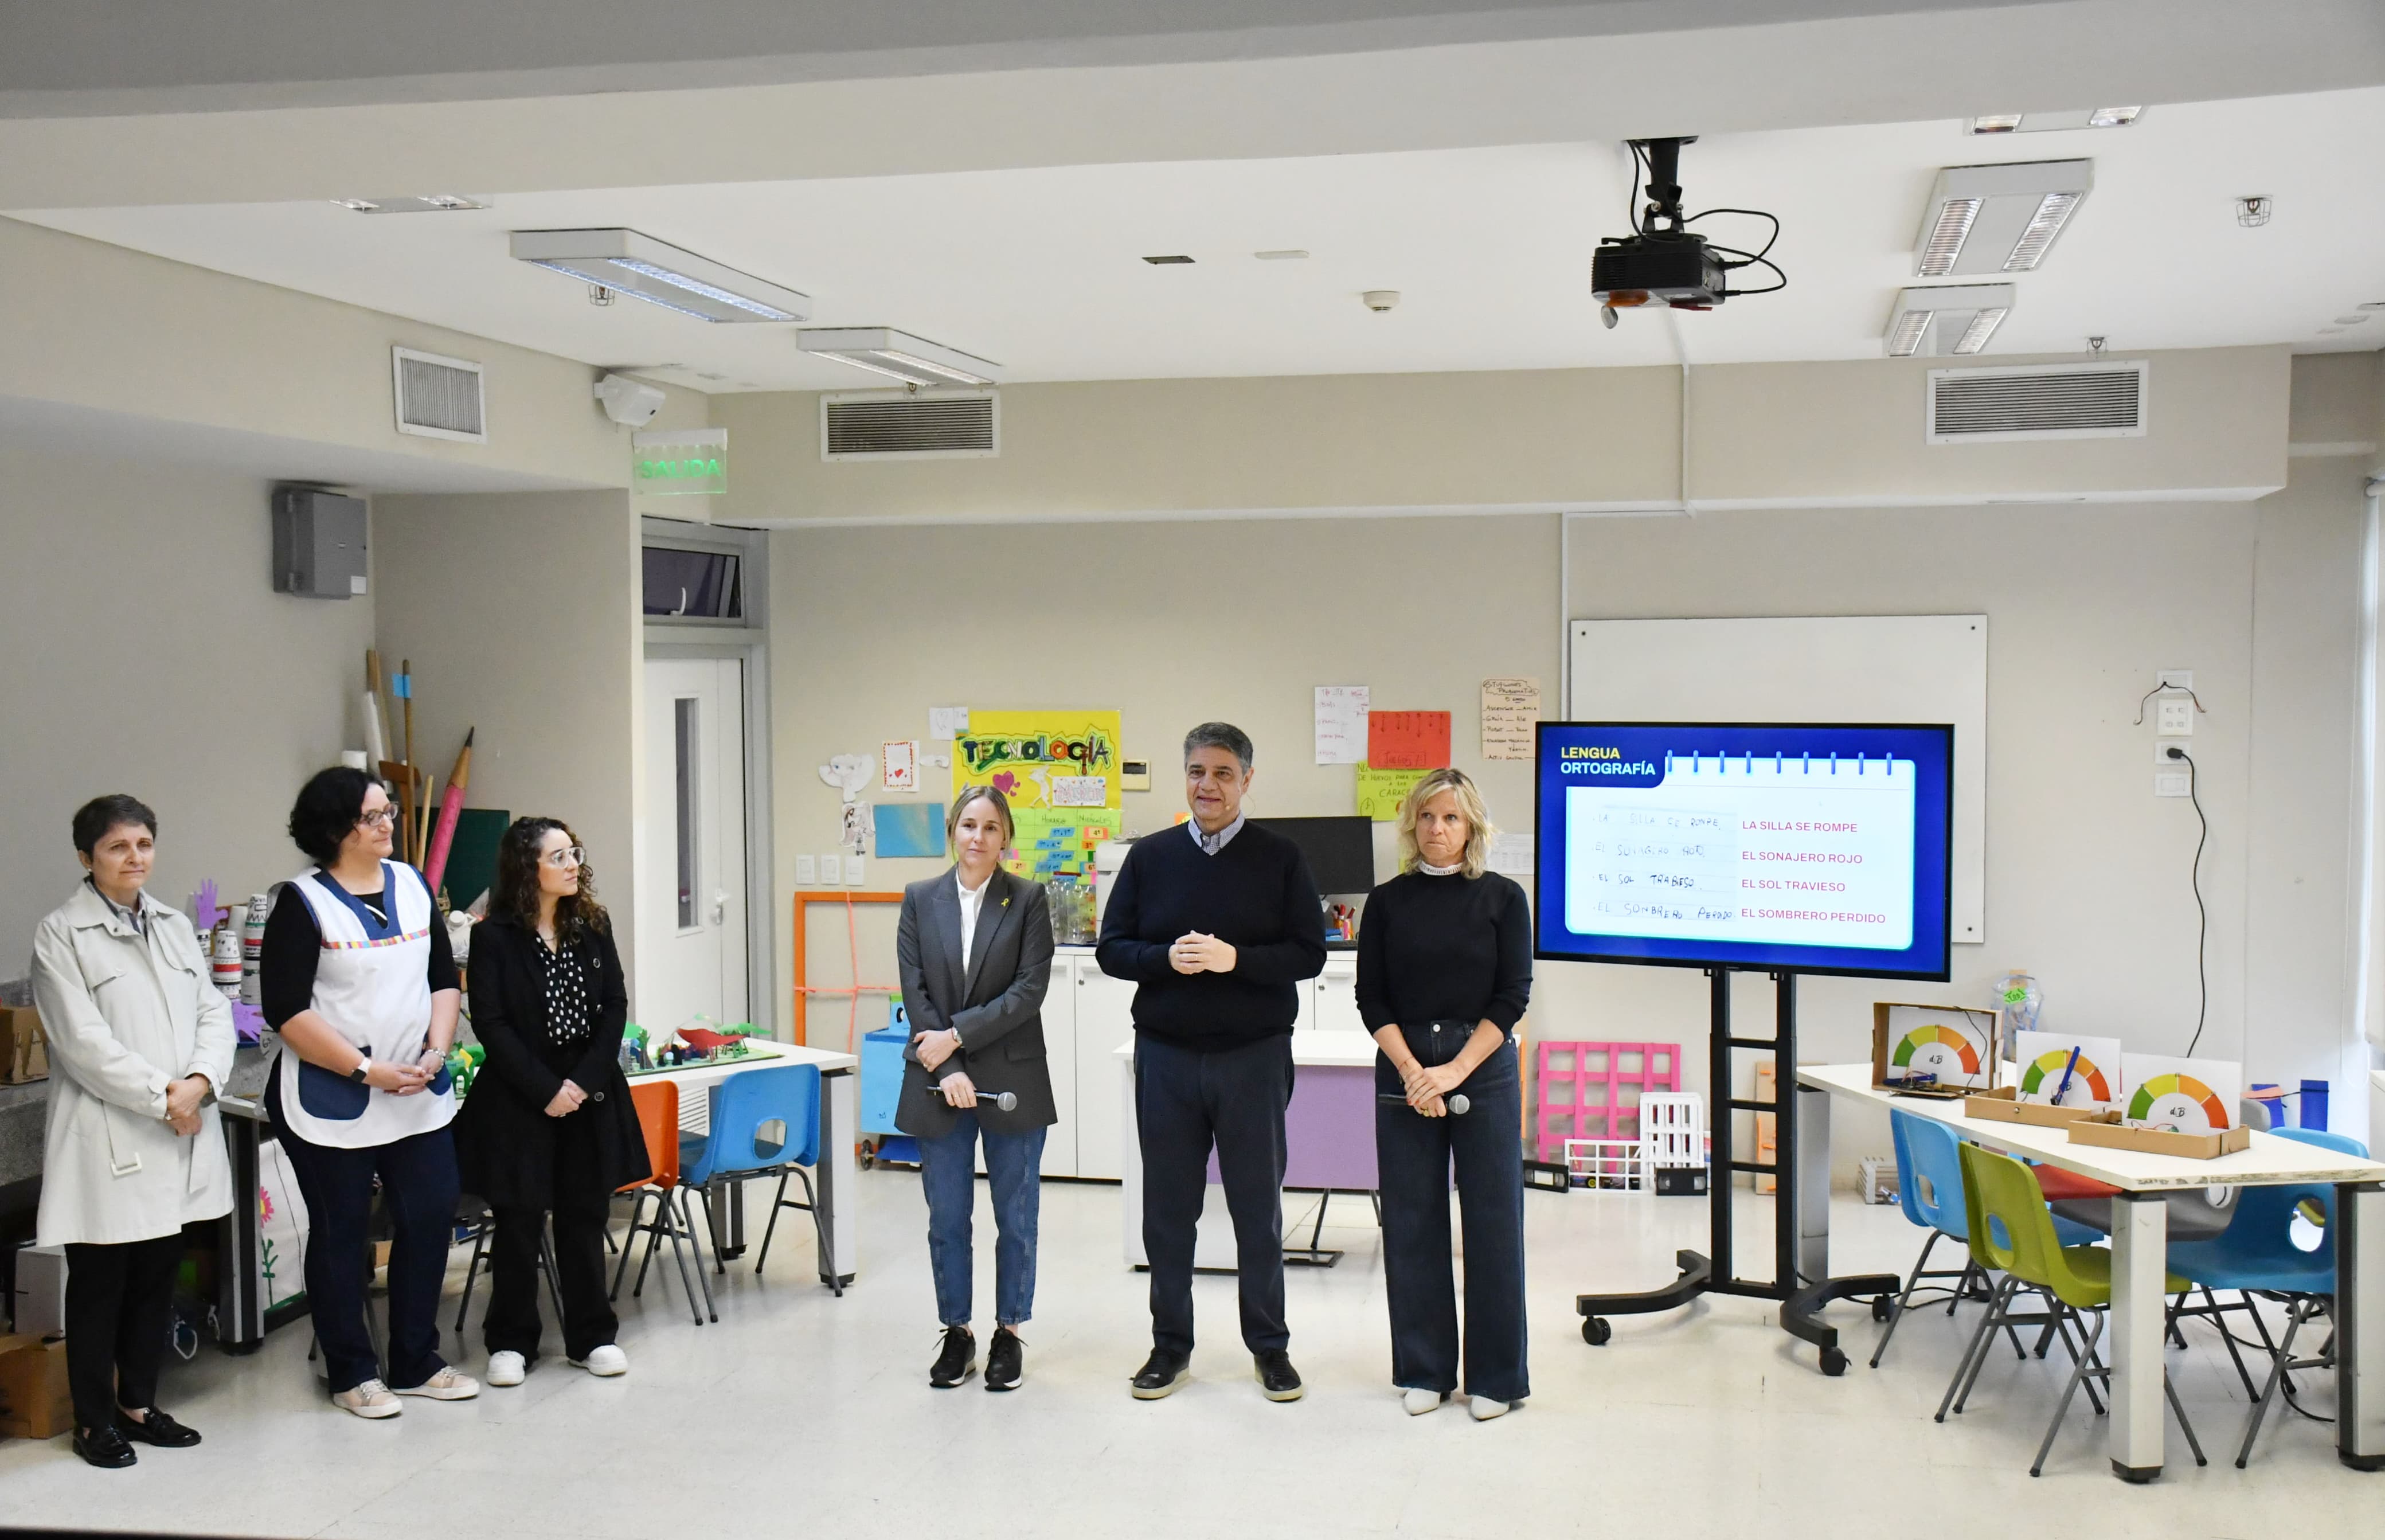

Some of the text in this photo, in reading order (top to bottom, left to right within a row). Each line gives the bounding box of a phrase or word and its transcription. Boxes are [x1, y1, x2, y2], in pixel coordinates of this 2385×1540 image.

[640, 458, 721, 479] SALIDA
[1561, 746, 1621, 759] LENGUA
[1561, 760, 1656, 775] ORTOGRAFÍA
[1598, 814, 1608, 822] LA
[1742, 821, 1858, 832] LA SILLA SE ROMPE
[1742, 851, 1863, 863] EL SONAJERO ROJO
[1598, 874, 1608, 882] EL
[1618, 874, 1635, 885] SOL
[1741, 880, 1846, 892] EL SOL TRAVIESO
[1597, 901, 1610, 913] EL
[1741, 908, 1886, 923] EL SOMBRERO PERDIDO
[2169, 1107, 2185, 1117] dB
